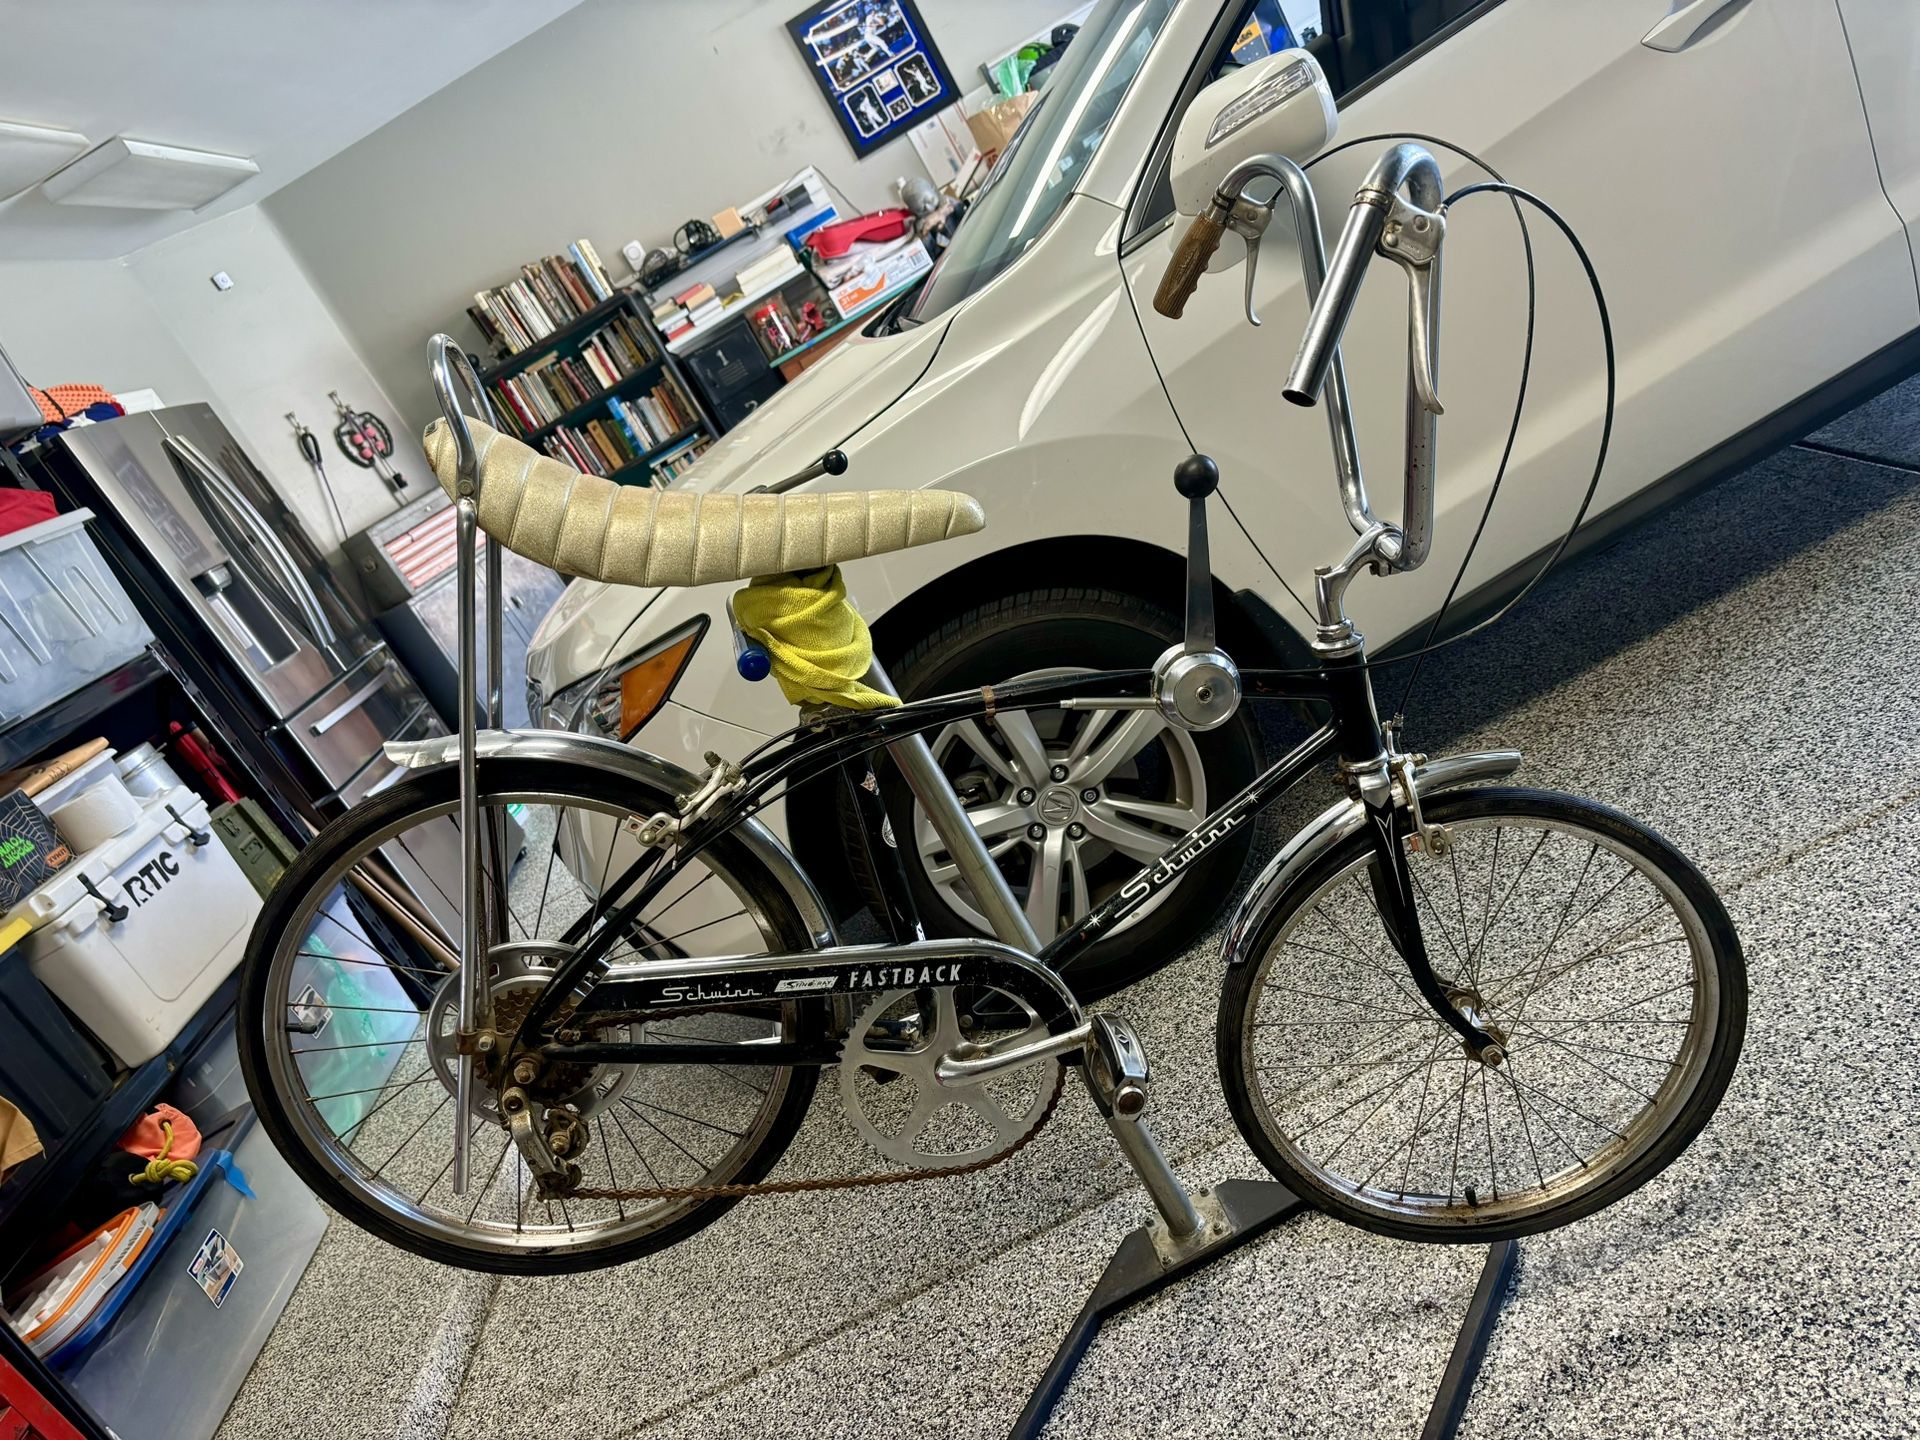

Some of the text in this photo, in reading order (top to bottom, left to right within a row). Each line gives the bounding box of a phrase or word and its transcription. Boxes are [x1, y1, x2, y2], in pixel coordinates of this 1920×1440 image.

[716, 350, 729, 366] 1
[1, 840, 35, 869] SPOOKY
[1114, 814, 1247, 919] Schwinn
[122, 851, 180, 907] RTIC
[650, 983, 763, 1004] Schwinn
[850, 964, 962, 988] FASTBACK
